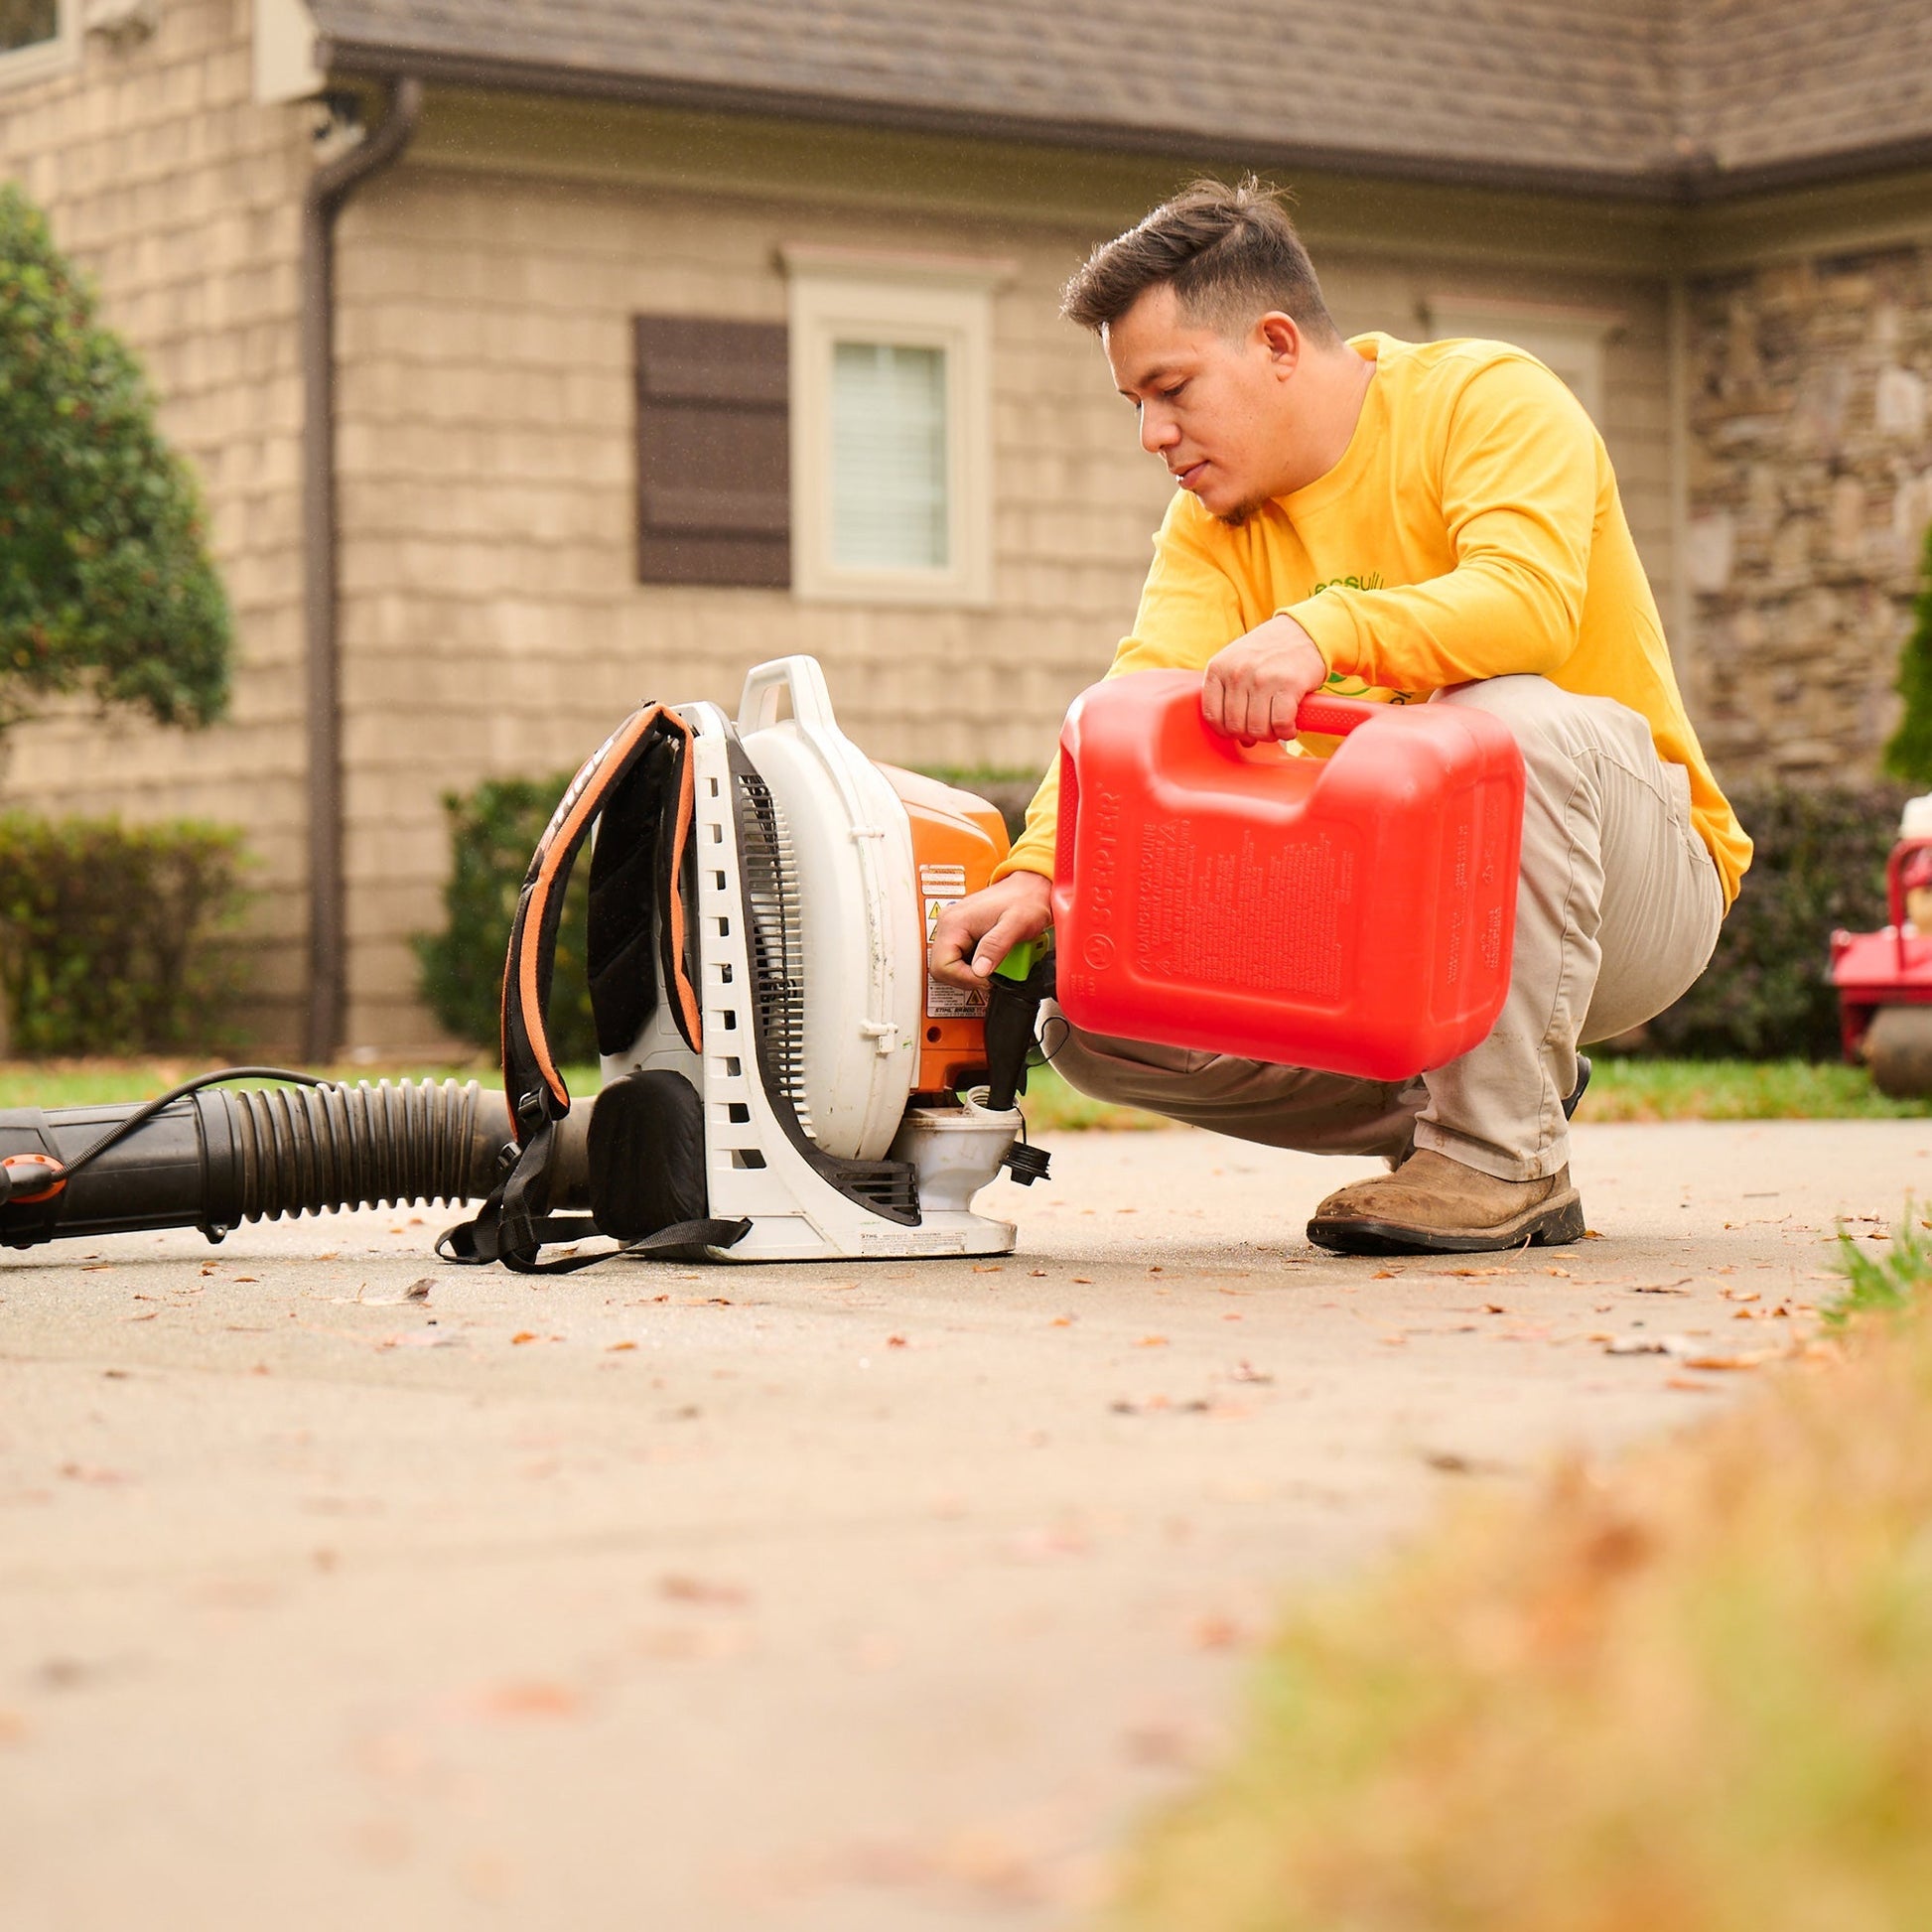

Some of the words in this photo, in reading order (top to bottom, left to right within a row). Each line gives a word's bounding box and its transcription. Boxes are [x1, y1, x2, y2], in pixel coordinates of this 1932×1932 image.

[1091, 791, 1121, 925] SCEPTER
[1139, 822, 1157, 893] GASOLINE
[1136, 897, 1153, 952] DANGER
